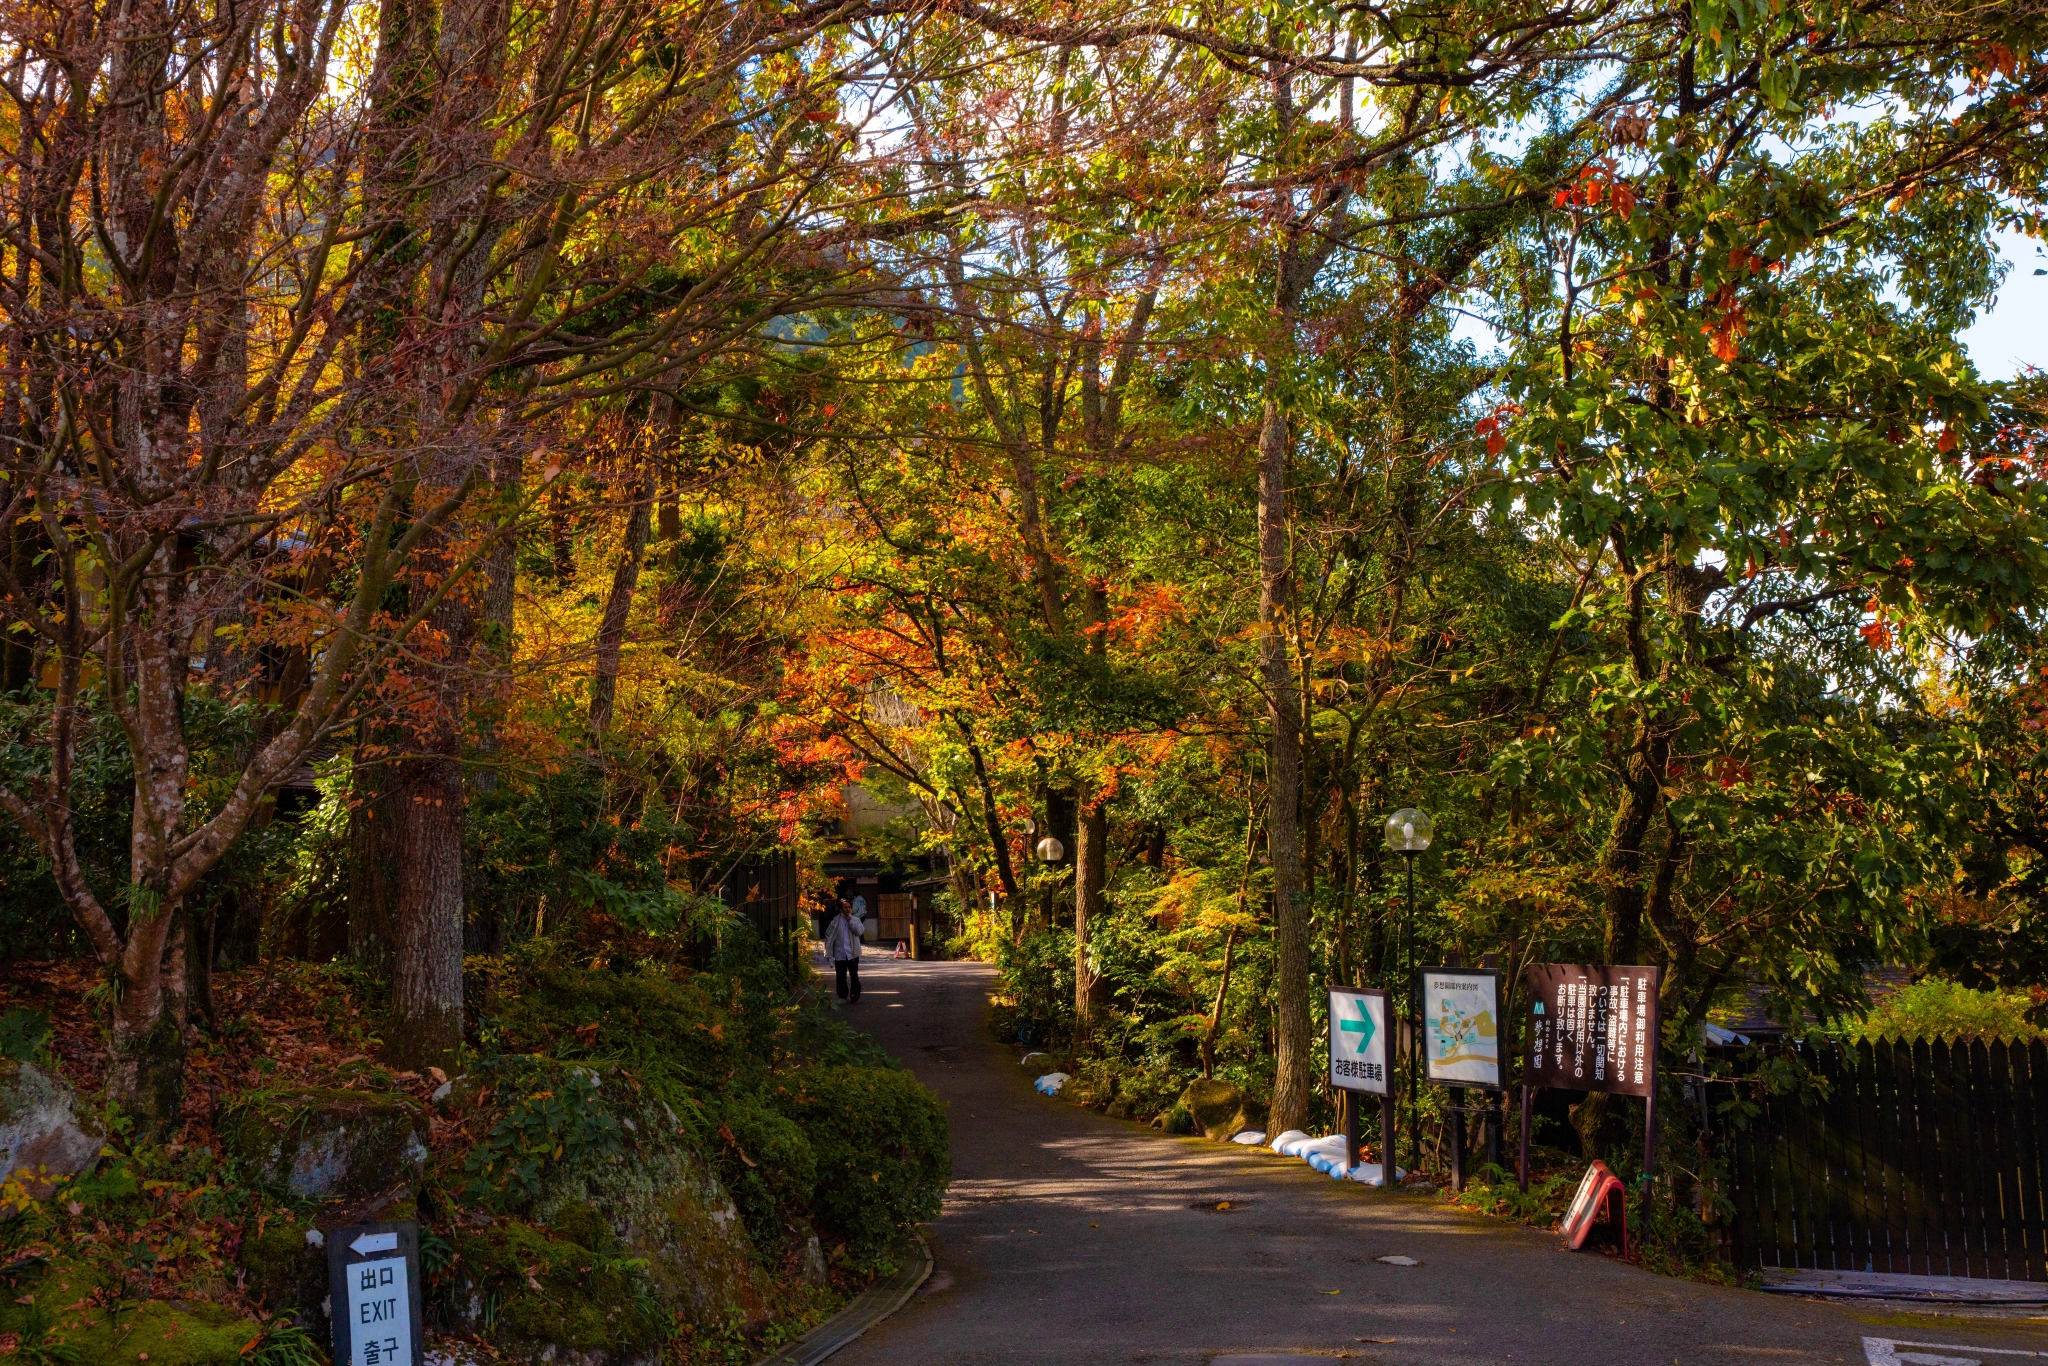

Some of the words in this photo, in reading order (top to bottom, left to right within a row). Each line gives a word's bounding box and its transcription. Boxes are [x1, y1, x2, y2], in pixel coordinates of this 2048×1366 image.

[1555, 984, 1566, 1070] お断り致します。
[1566, 984, 1577, 1042] 駐車は固く
[1574, 975, 1587, 1078] 一、当園御利用以外の
[1587, 984, 1598, 1049] 致しません。
[1595, 986, 1608, 1080] ついては一切関知
[1607, 985, 1618, 1062] 事故、盗難等に
[1617, 977, 1630, 1082] 一、駐車場内における
[1634, 978, 1647, 1084] 駐車場御利用注意
[1335, 1058, 1382, 1082] お客様駐車場
[360, 1298, 397, 1324] EXIT
[361, 1266, 393, 1291] 出口
[364, 1337, 399, 1366] 출구
